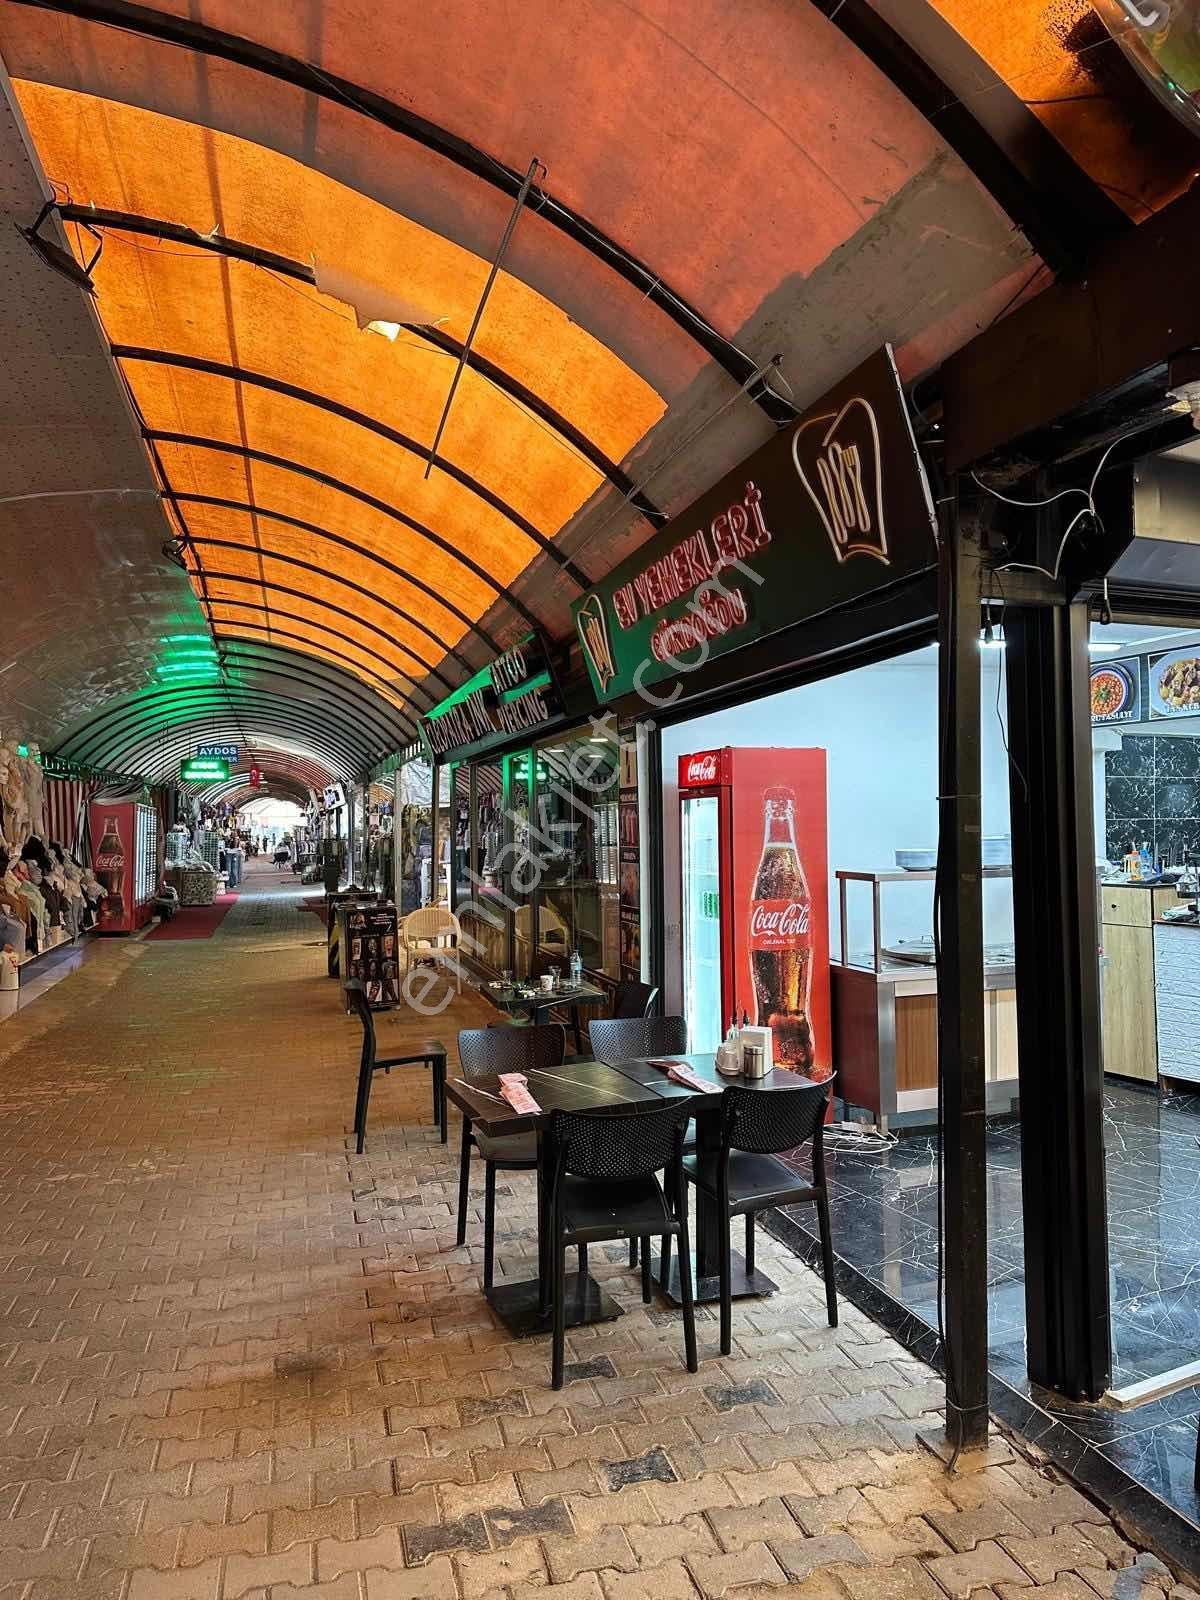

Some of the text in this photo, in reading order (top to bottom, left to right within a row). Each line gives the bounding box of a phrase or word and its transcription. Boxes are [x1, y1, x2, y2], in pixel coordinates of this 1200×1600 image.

[613, 481, 772, 629] EV YEMEKLERİ
[199, 747, 237, 755] AYDOS
[751, 902, 810, 937] Coca-Cola
